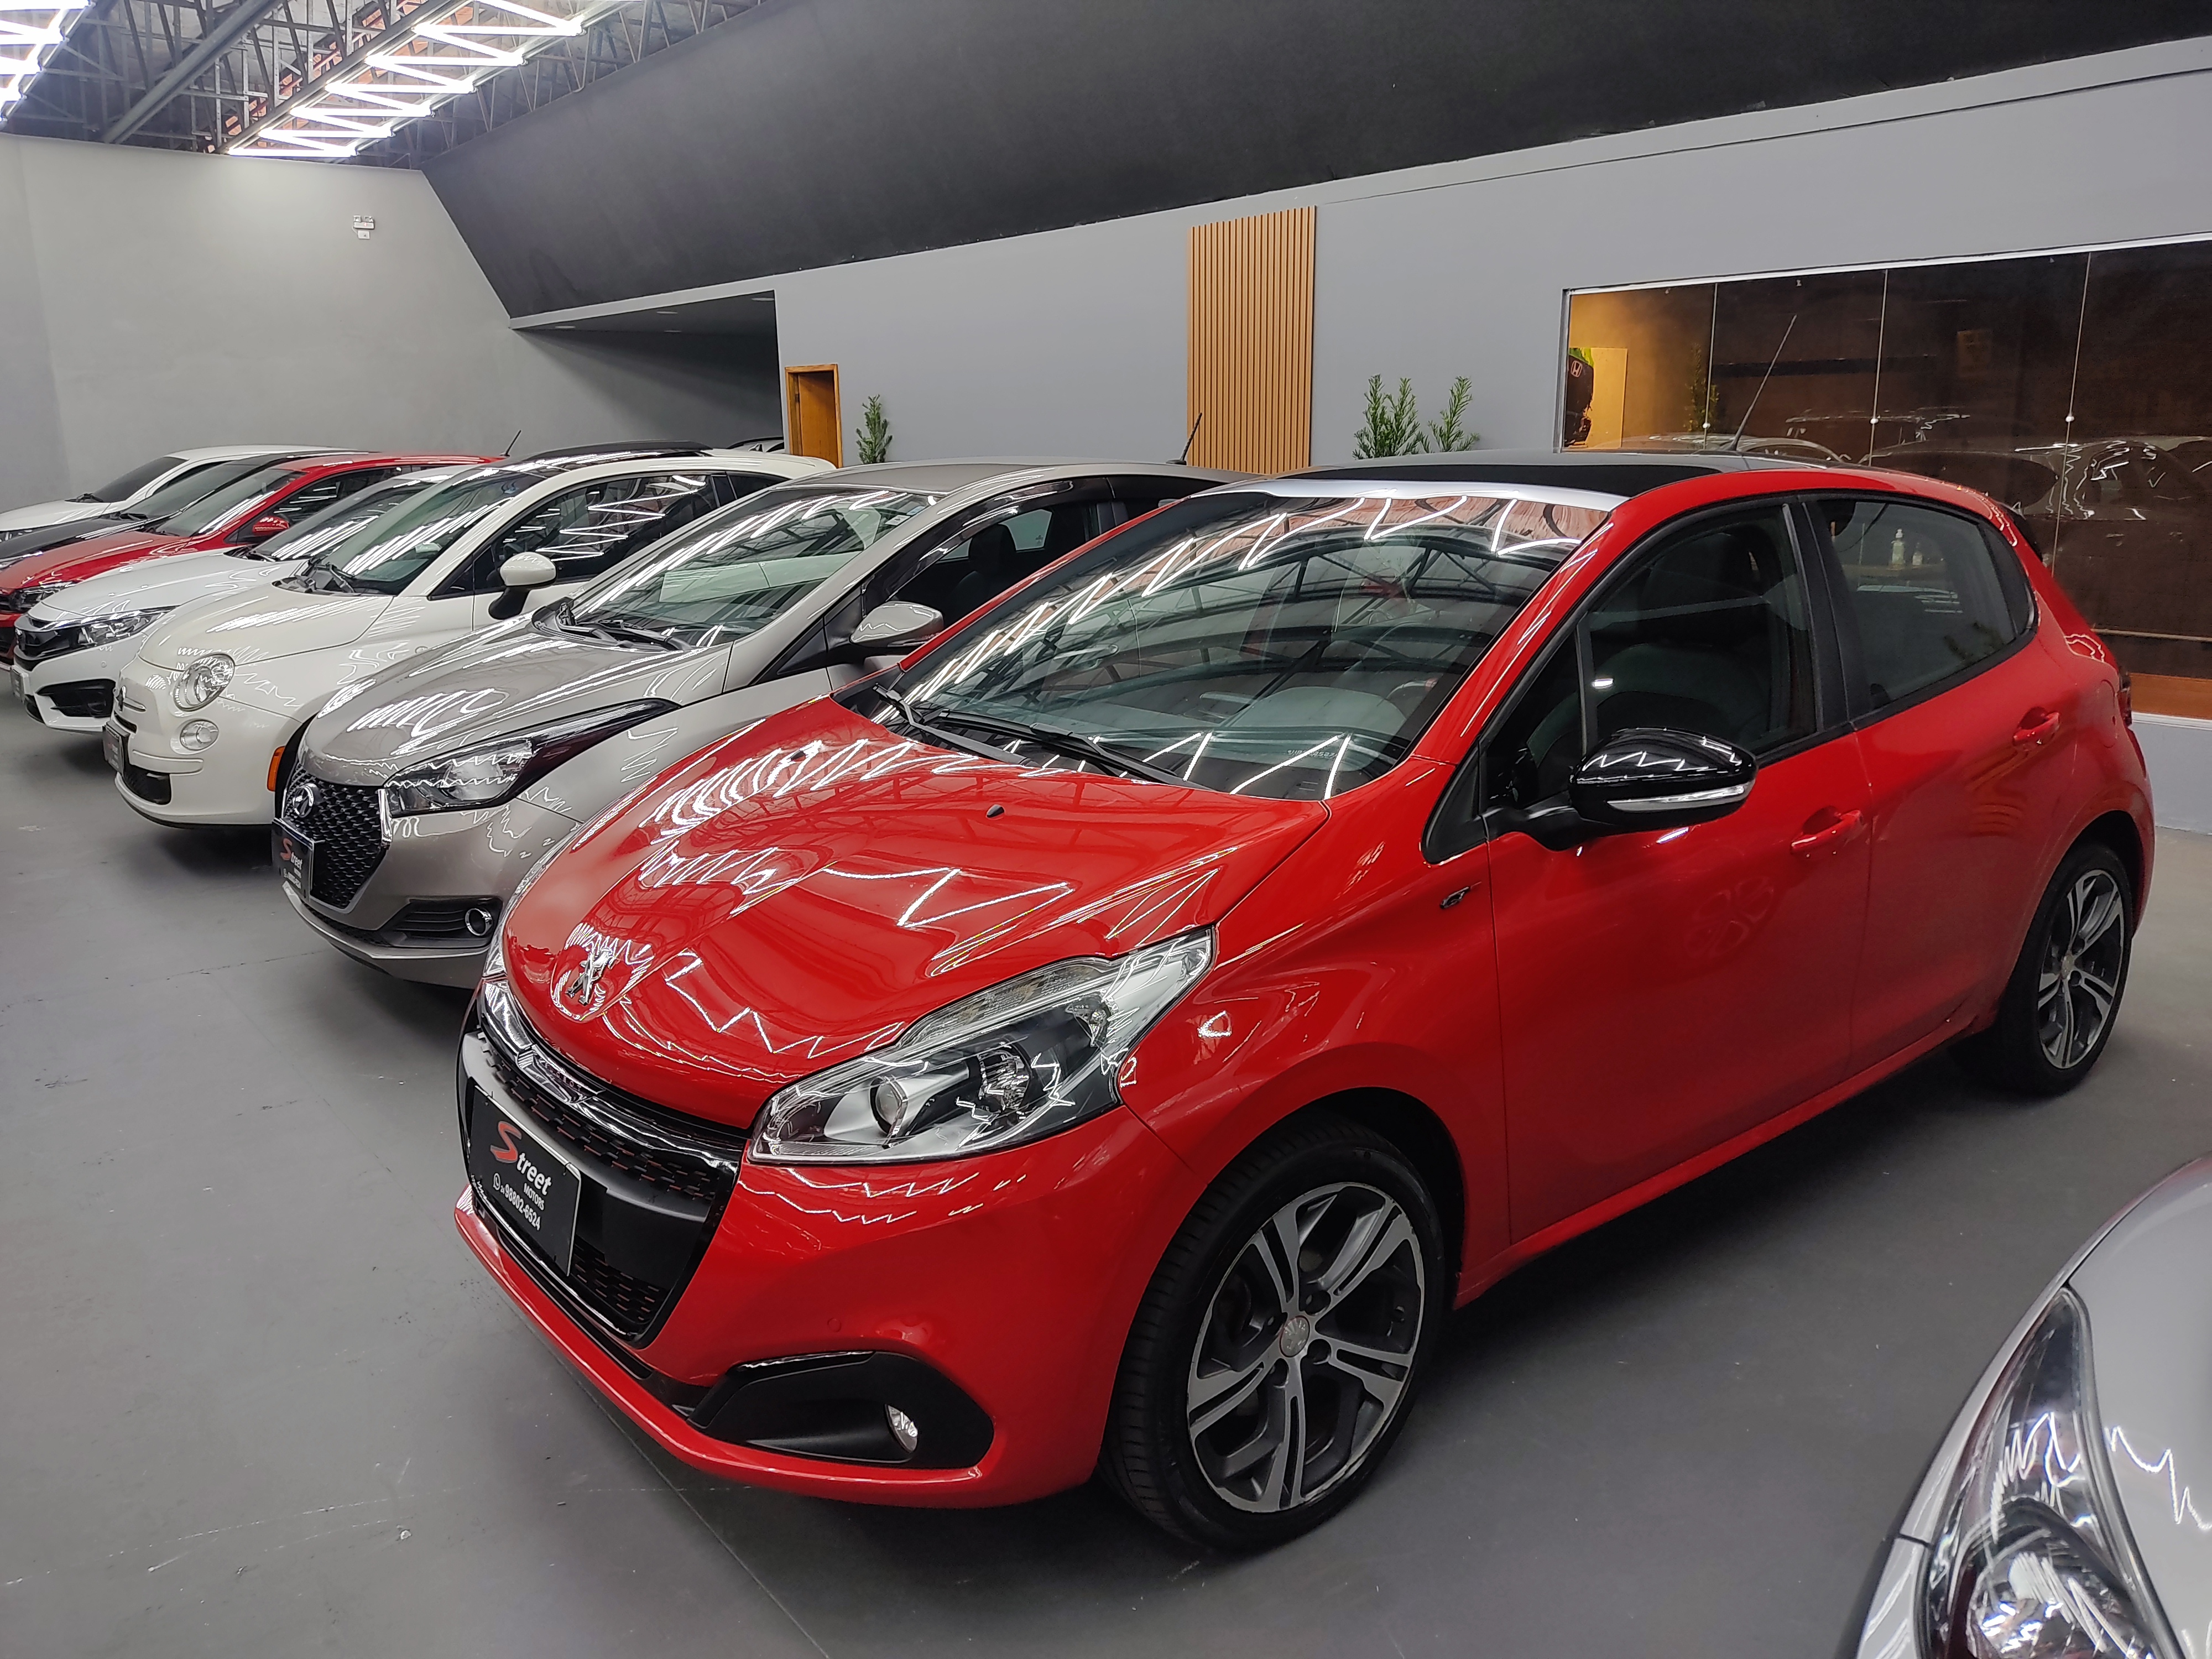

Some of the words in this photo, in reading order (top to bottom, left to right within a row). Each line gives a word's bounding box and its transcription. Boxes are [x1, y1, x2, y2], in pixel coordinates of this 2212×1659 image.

[280, 838, 303, 870] Street
[490, 1121, 552, 1196] Street
[505, 1183, 541, 1231] 98802-6524
[523, 1182, 545, 1211] MOTORS
